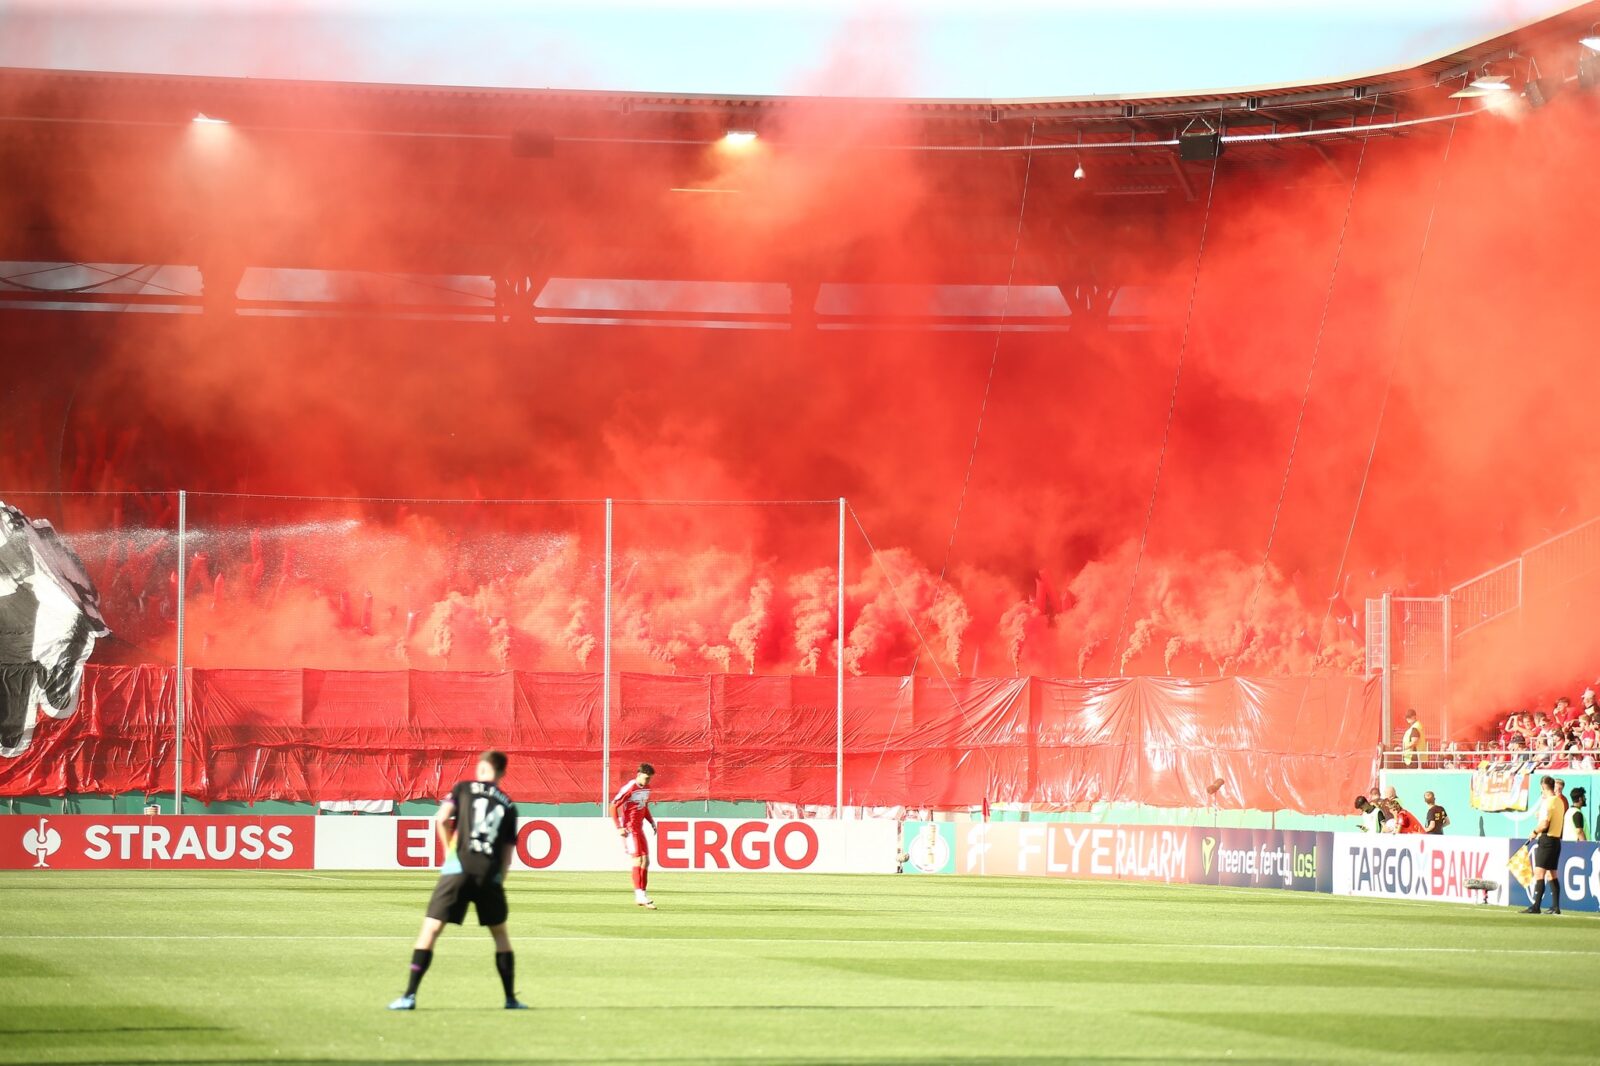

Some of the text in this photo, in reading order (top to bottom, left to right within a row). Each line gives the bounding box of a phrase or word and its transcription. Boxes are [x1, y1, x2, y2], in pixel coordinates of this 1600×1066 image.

[83, 824, 294, 861] STRAUSS
[396, 819, 562, 869] EO
[472, 797, 505, 845] 14
[656, 820, 819, 870] ERGO
[1017, 827, 1188, 880] FLYERALARM
[1293, 845, 1317, 878] los!
